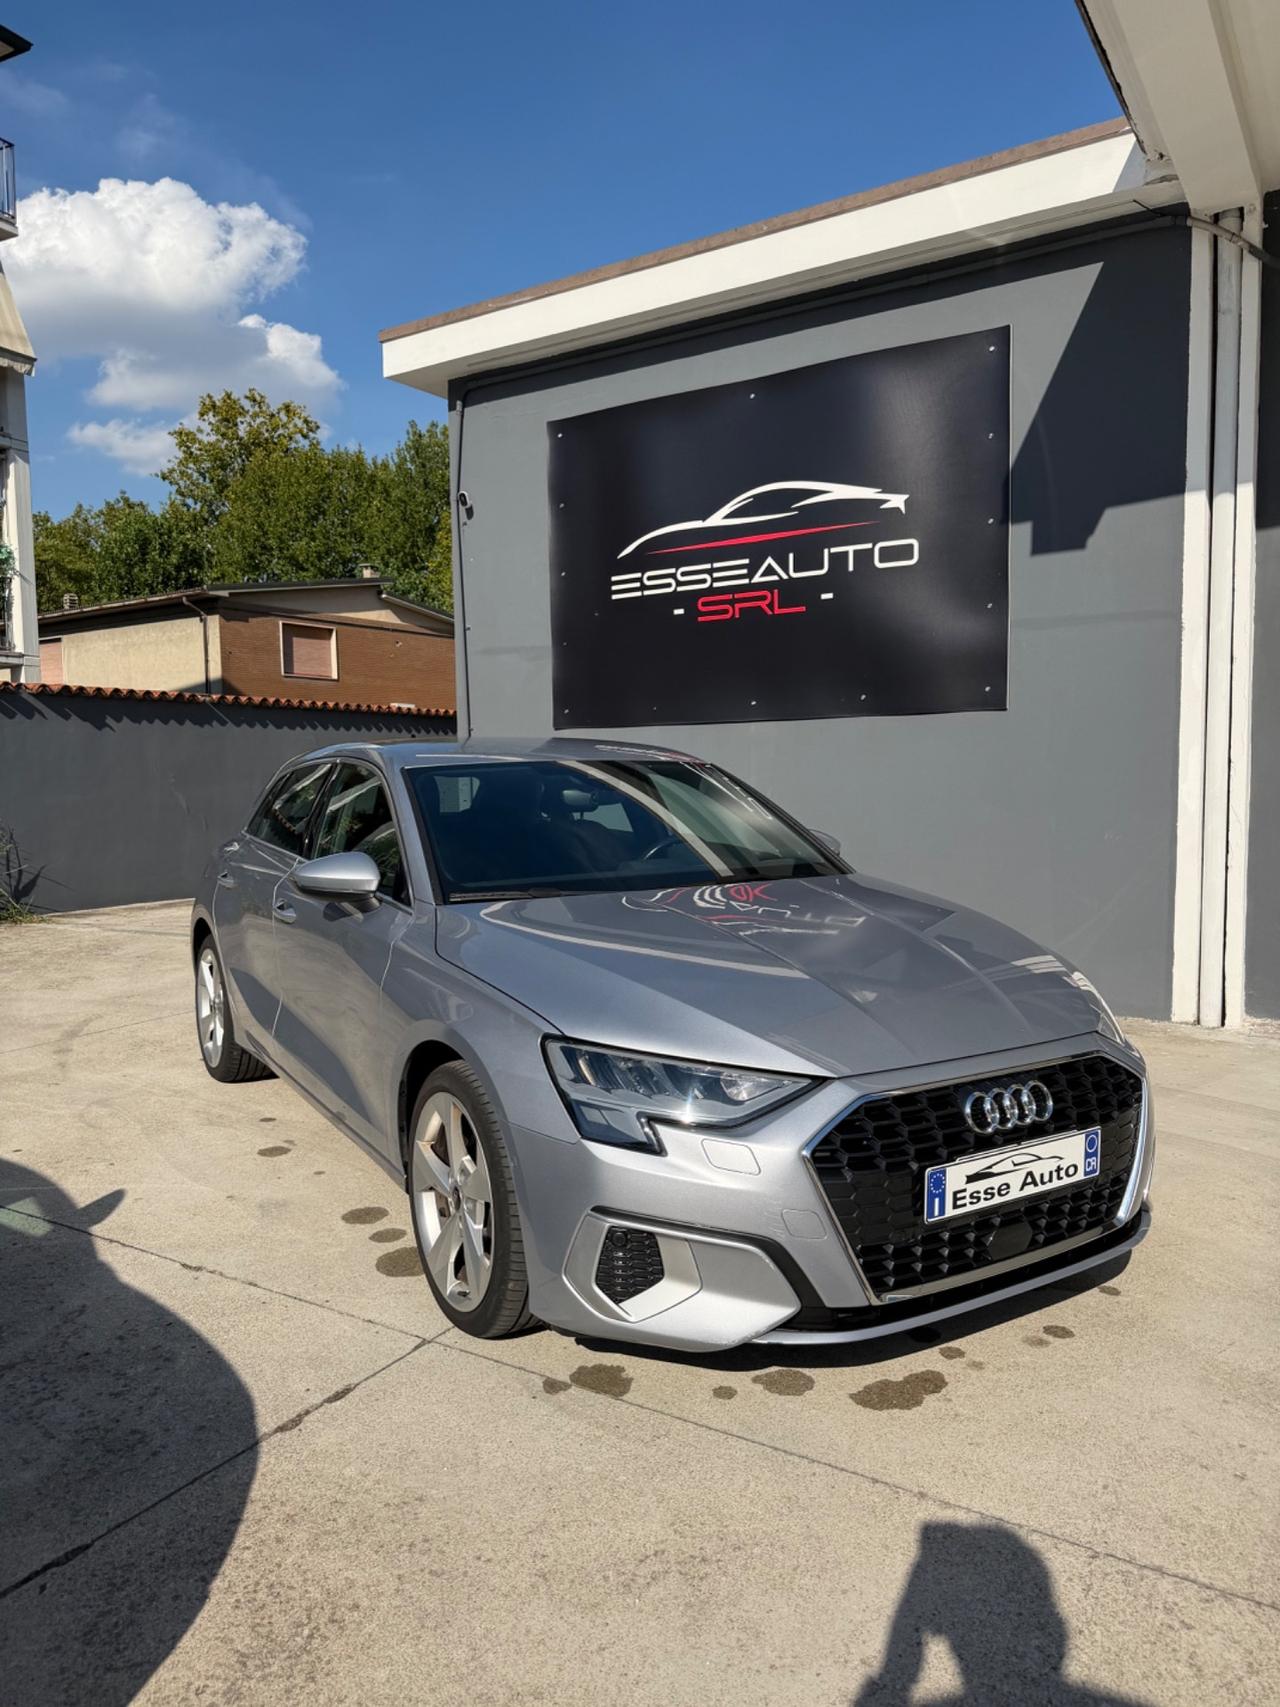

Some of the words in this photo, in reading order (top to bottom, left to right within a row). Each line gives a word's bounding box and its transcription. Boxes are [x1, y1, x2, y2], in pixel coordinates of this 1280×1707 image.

[611, 538, 919, 600] ESSEAUTO
[697, 589, 806, 621] SRL
[952, 1182, 1011, 1210] Esse
[1019, 1163, 1079, 1192] Auto
